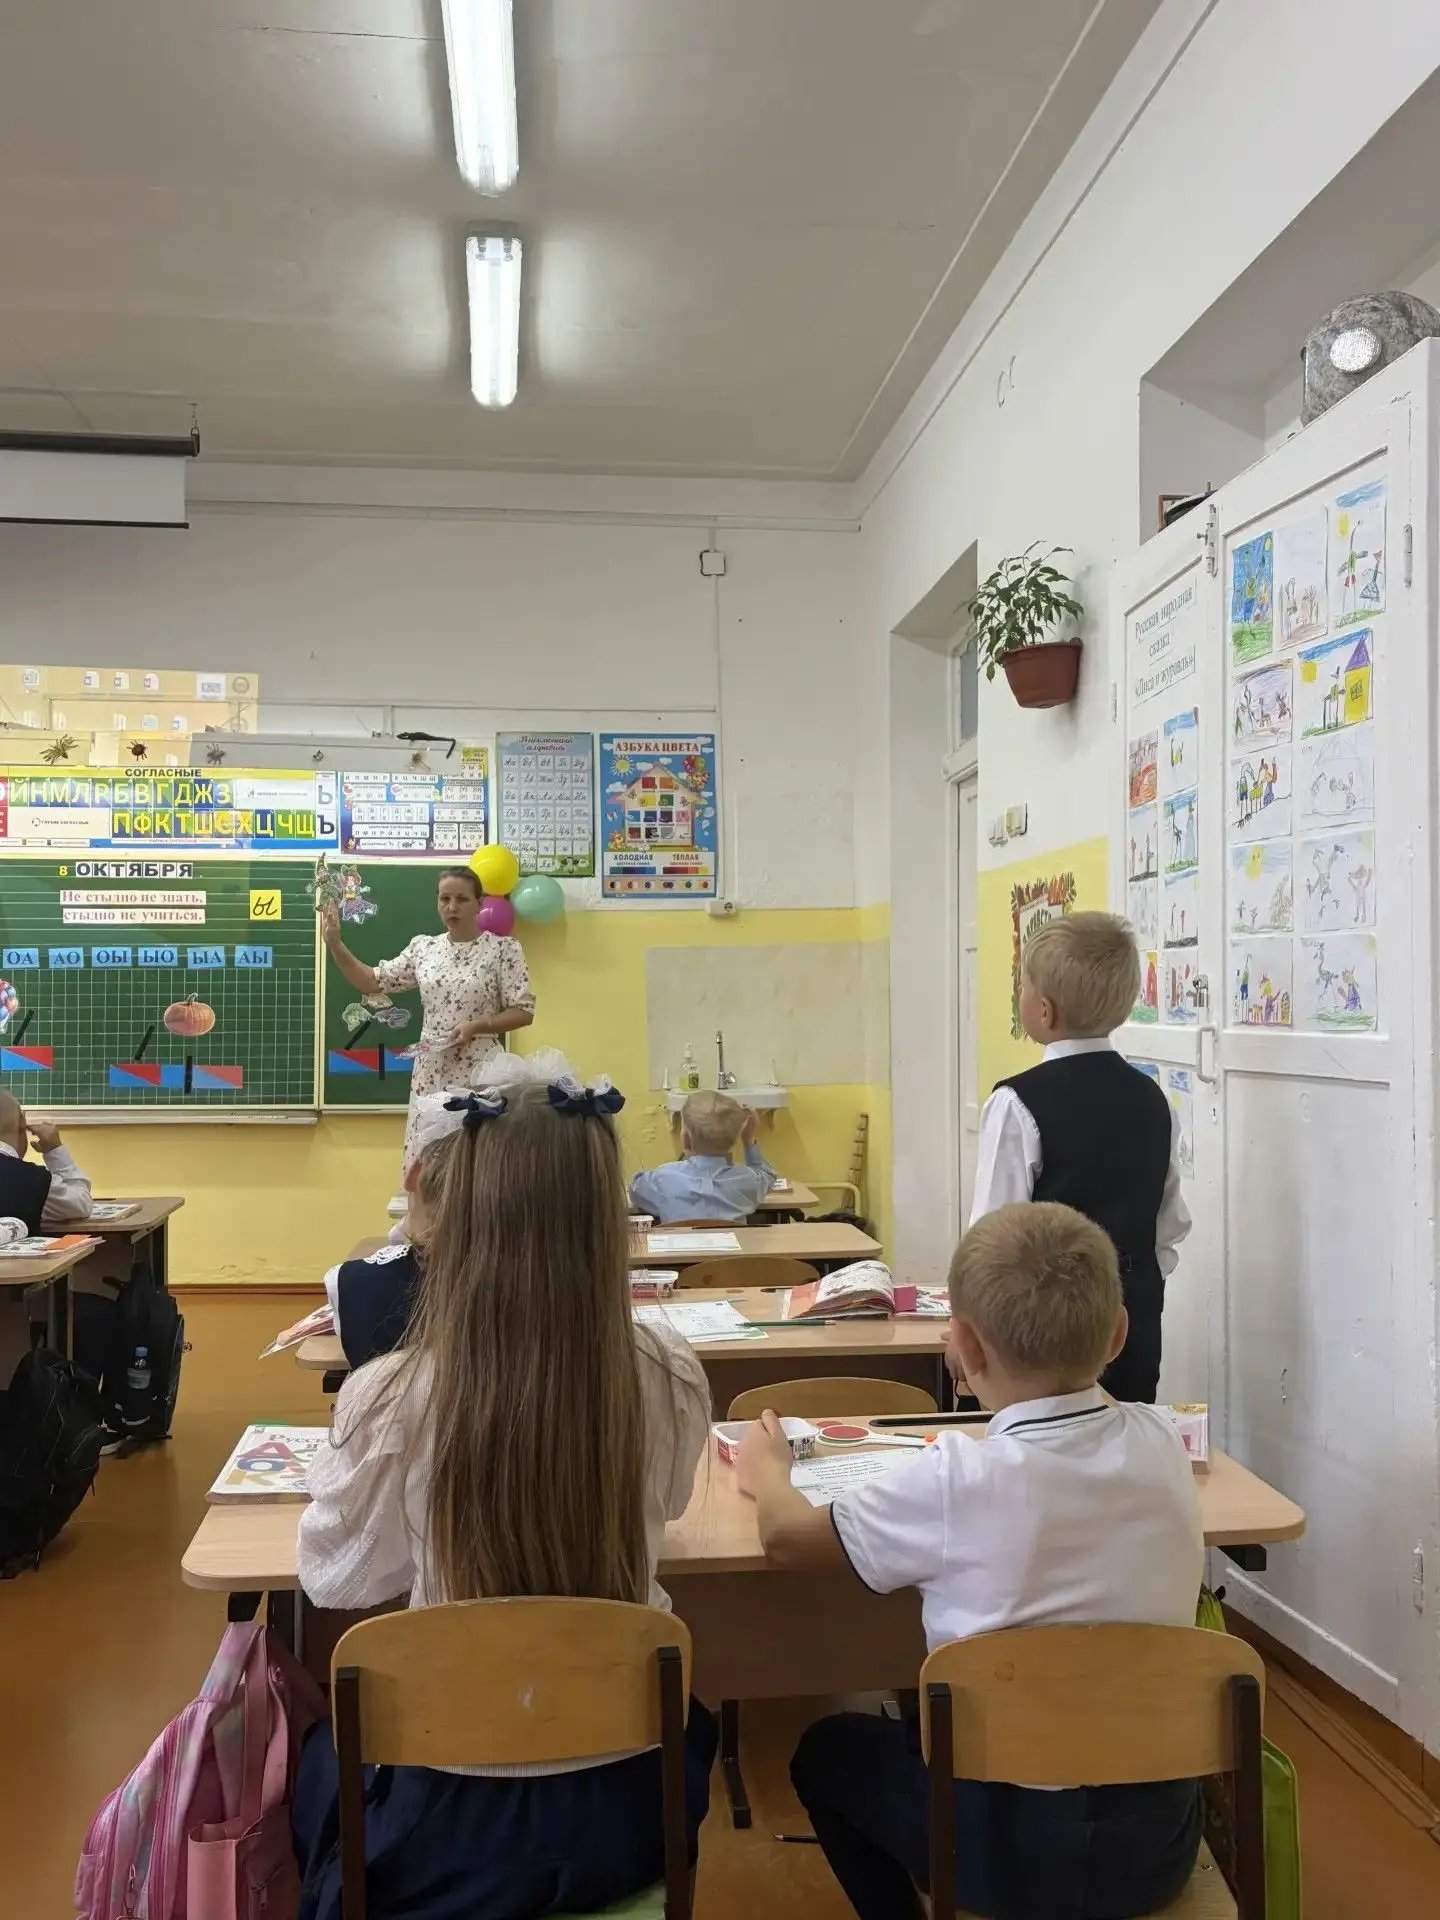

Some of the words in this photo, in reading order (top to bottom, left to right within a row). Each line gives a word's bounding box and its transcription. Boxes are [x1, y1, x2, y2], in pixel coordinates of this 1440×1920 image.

[1135, 612, 1159, 640] Русская
[1161, 587, 1193, 621] народная
[615, 743, 660, 753] АЗБУКА
[662, 742, 699, 753] ЦВЕТА
[125, 768, 202, 777] СОГЛАСНЫЕ
[59, 865, 69, 876] 8
[77, 863, 193, 878] ОКТЯБРЯ
[62, 891, 81, 903] Не
[86, 892, 138, 905] стыдно
[140, 894, 158, 904] не
[160, 893, 204, 905] знать,
[63, 910, 116, 922] стыдно
[120, 911, 137, 922] не
[141, 911, 203, 923] учиться.
[7, 951, 34, 965] ОА
[53, 951, 81, 965] АО
[96, 949, 127, 964] ОЫ
[143, 949, 175, 963] ЫО
[192, 949, 223, 965] ЫА
[237, 951, 269, 965] АЫ
